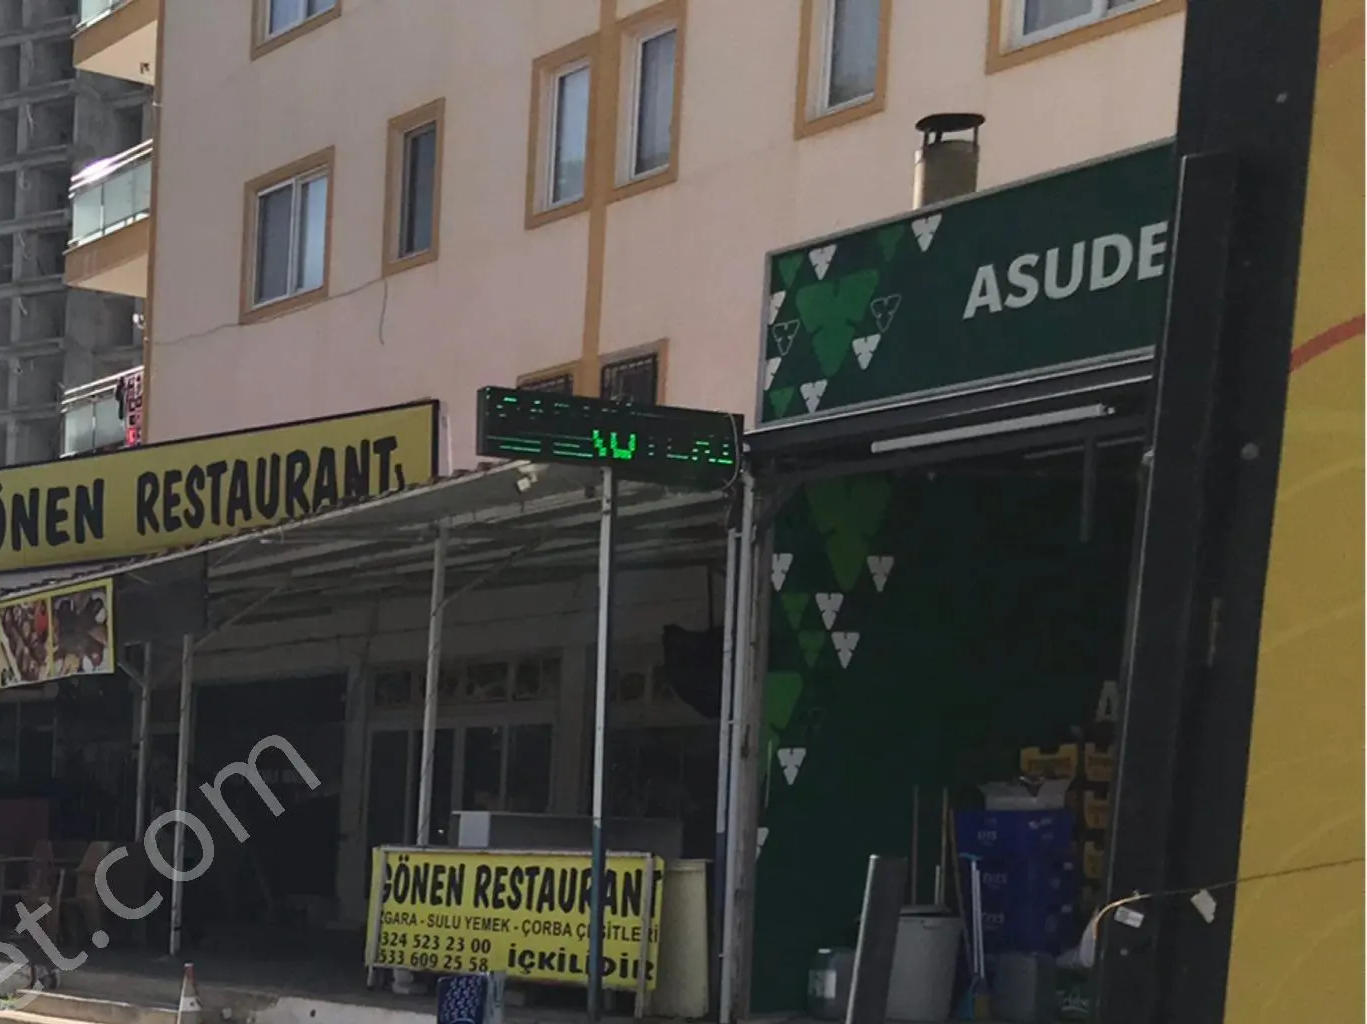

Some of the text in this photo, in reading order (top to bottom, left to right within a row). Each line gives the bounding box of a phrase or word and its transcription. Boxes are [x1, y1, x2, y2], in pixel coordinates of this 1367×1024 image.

[962, 220, 1169, 320] ASUDE
[137, 435, 398, 536] RESTAURANT
[427, 913, 461, 930] SULU
[465, 915, 511, 933] YEMEK
[522, 919, 572, 937] ÇORBA
[412, 934, 440, 951] 523
[445, 936, 465, 952] 23
[471, 938, 491, 954] 00
[409, 952, 438, 967] 609
[443, 954, 463, 970] 25
[468, 956, 489, 972] 58
